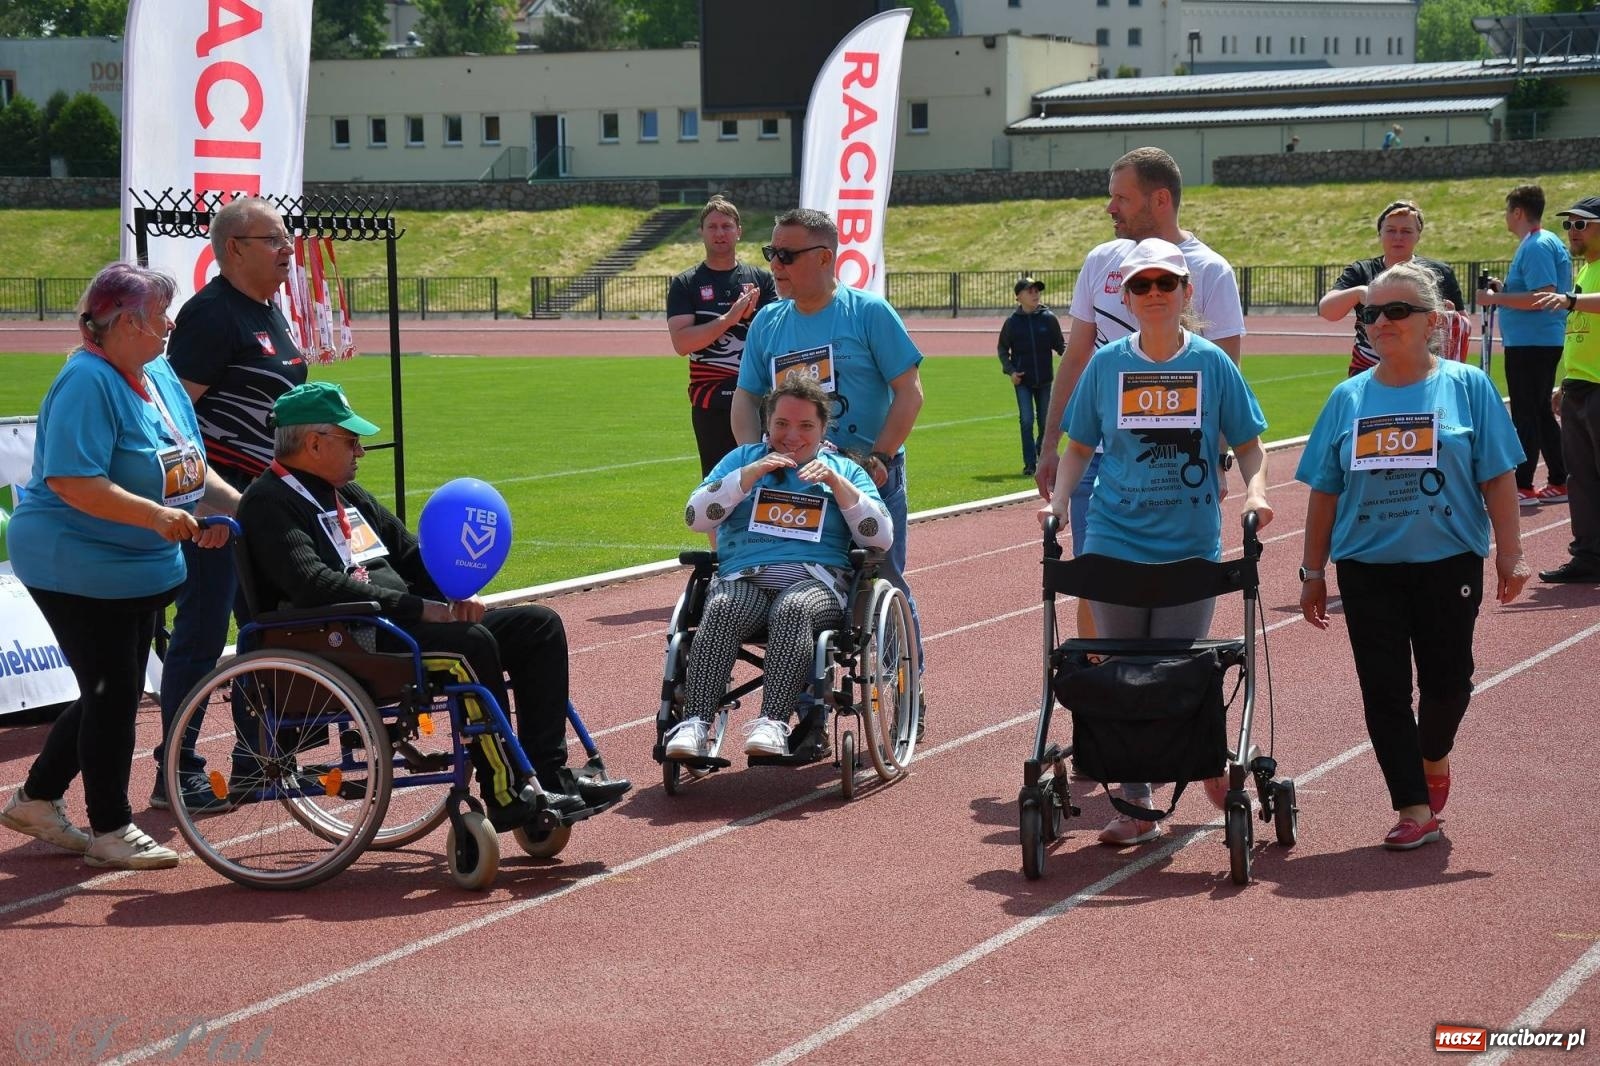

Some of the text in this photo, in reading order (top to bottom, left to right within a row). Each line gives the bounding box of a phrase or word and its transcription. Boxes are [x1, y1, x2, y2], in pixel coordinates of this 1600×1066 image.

[91, 61, 123, 81] DO
[1138, 390, 1180, 410] 018
[1375, 431, 1417, 451] 150
[465, 506, 497, 526] TEB
[768, 505, 807, 526] 066
[455, 559, 488, 569] EDUKACJA
[0, 639, 70, 678] iekun
